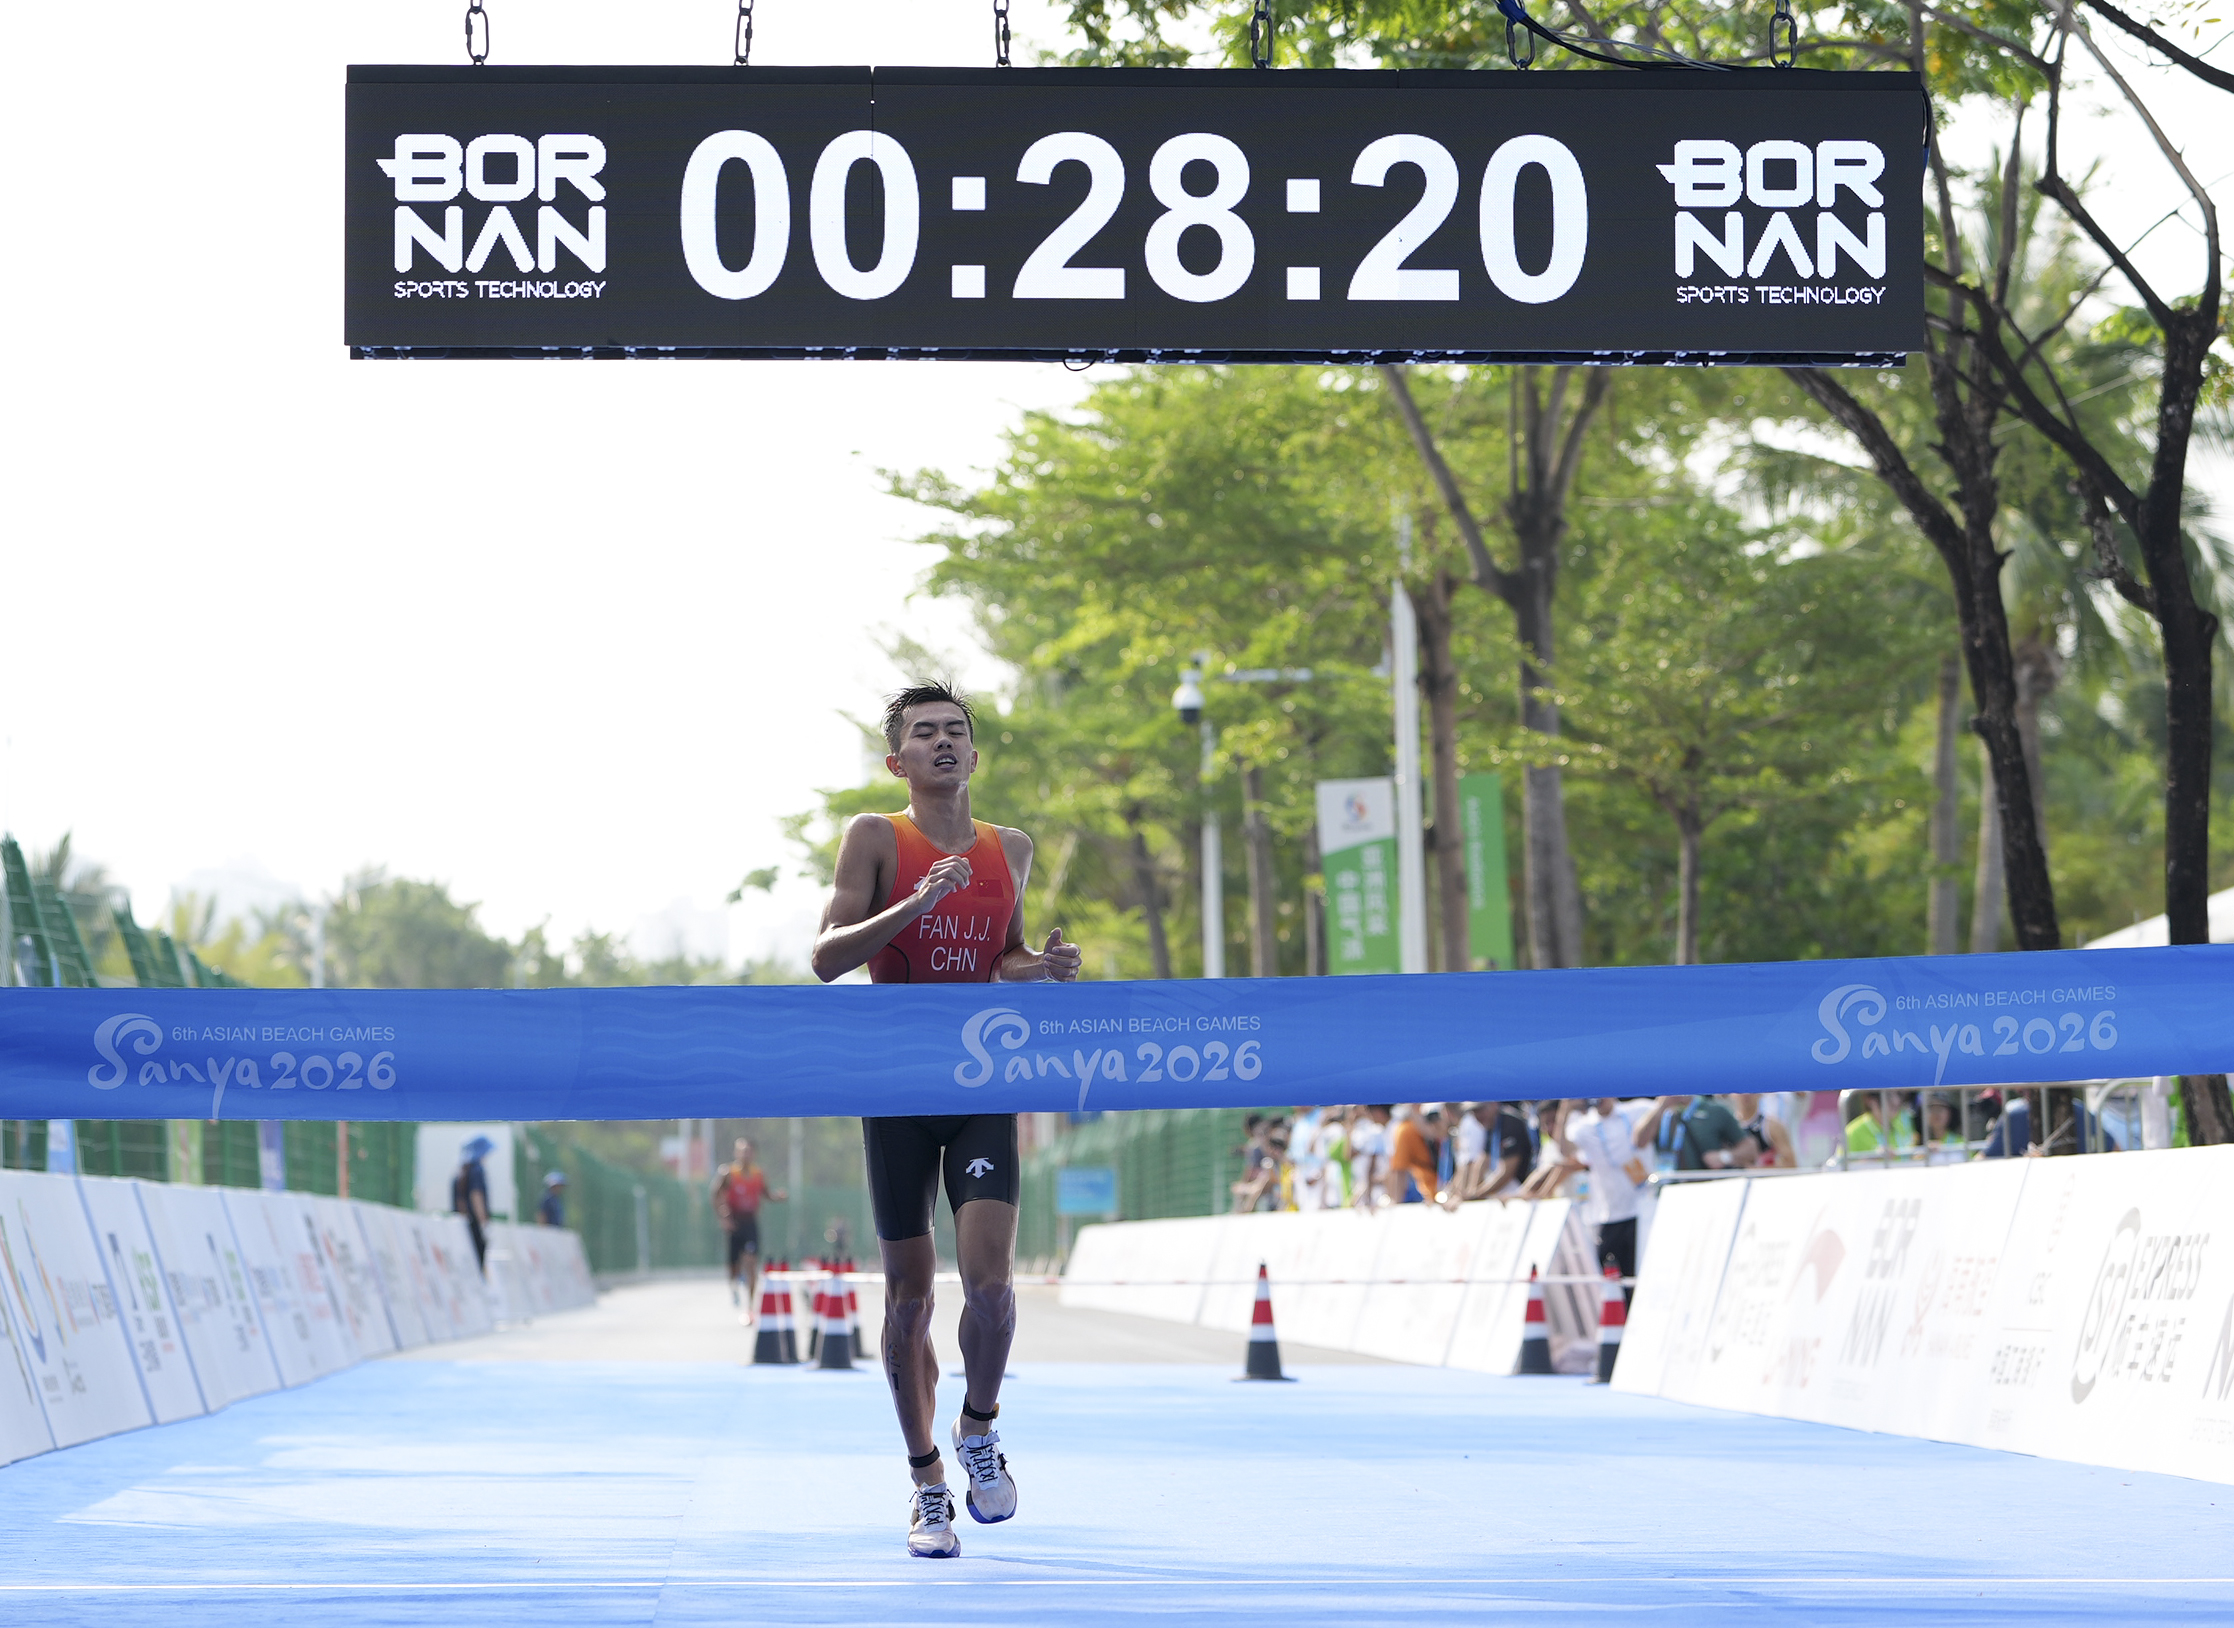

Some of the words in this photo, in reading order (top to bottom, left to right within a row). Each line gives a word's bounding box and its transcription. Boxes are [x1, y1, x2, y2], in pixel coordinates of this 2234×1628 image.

[376, 134, 606, 201] BOR
[1656, 140, 1885, 207] BOR
[395, 206, 606, 273] NAN
[681, 130, 1587, 304] 00:28:20
[1675, 211, 1886, 279] NAN
[395, 281, 469, 299] SPORTS
[475, 281, 606, 299] TECHNOLOGY
[1676, 286, 1749, 304] SPORTS
[1754, 286, 1886, 304] TECHNOLOGY
[919, 915, 959, 940] FAN
[963, 915, 991, 942] J.J.
[931, 946, 977, 972] CHN
[1039, 1020, 1064, 1036] 6th
[1068, 1018, 1123, 1034] ASIAN
[1129, 1017, 1190, 1033] BEACH
[1196, 1016, 1261, 1032] GAMES
[1895, 995, 1921, 1011] 6th
[1925, 993, 1979, 1009] ASIAN
[1985, 990, 2046, 1007] BEACH
[2052, 986, 2116, 1004] GAMES
[87, 1012, 263, 1120] Sanya
[269, 1051, 397, 1091] 2026
[172, 1027, 197, 1041] 6th
[201, 1027, 256, 1041] ASIAN
[262, 1027, 324, 1042] BEACH
[330, 1027, 395, 1042] GAMES
[953, 1007, 1128, 1112] Sanya
[1136, 1040, 1262, 1083] 2026
[1811, 984, 1985, 1086] Sanya
[1993, 1010, 2118, 1057] 2026
[2130, 1232, 2210, 1300] EXPRESS
